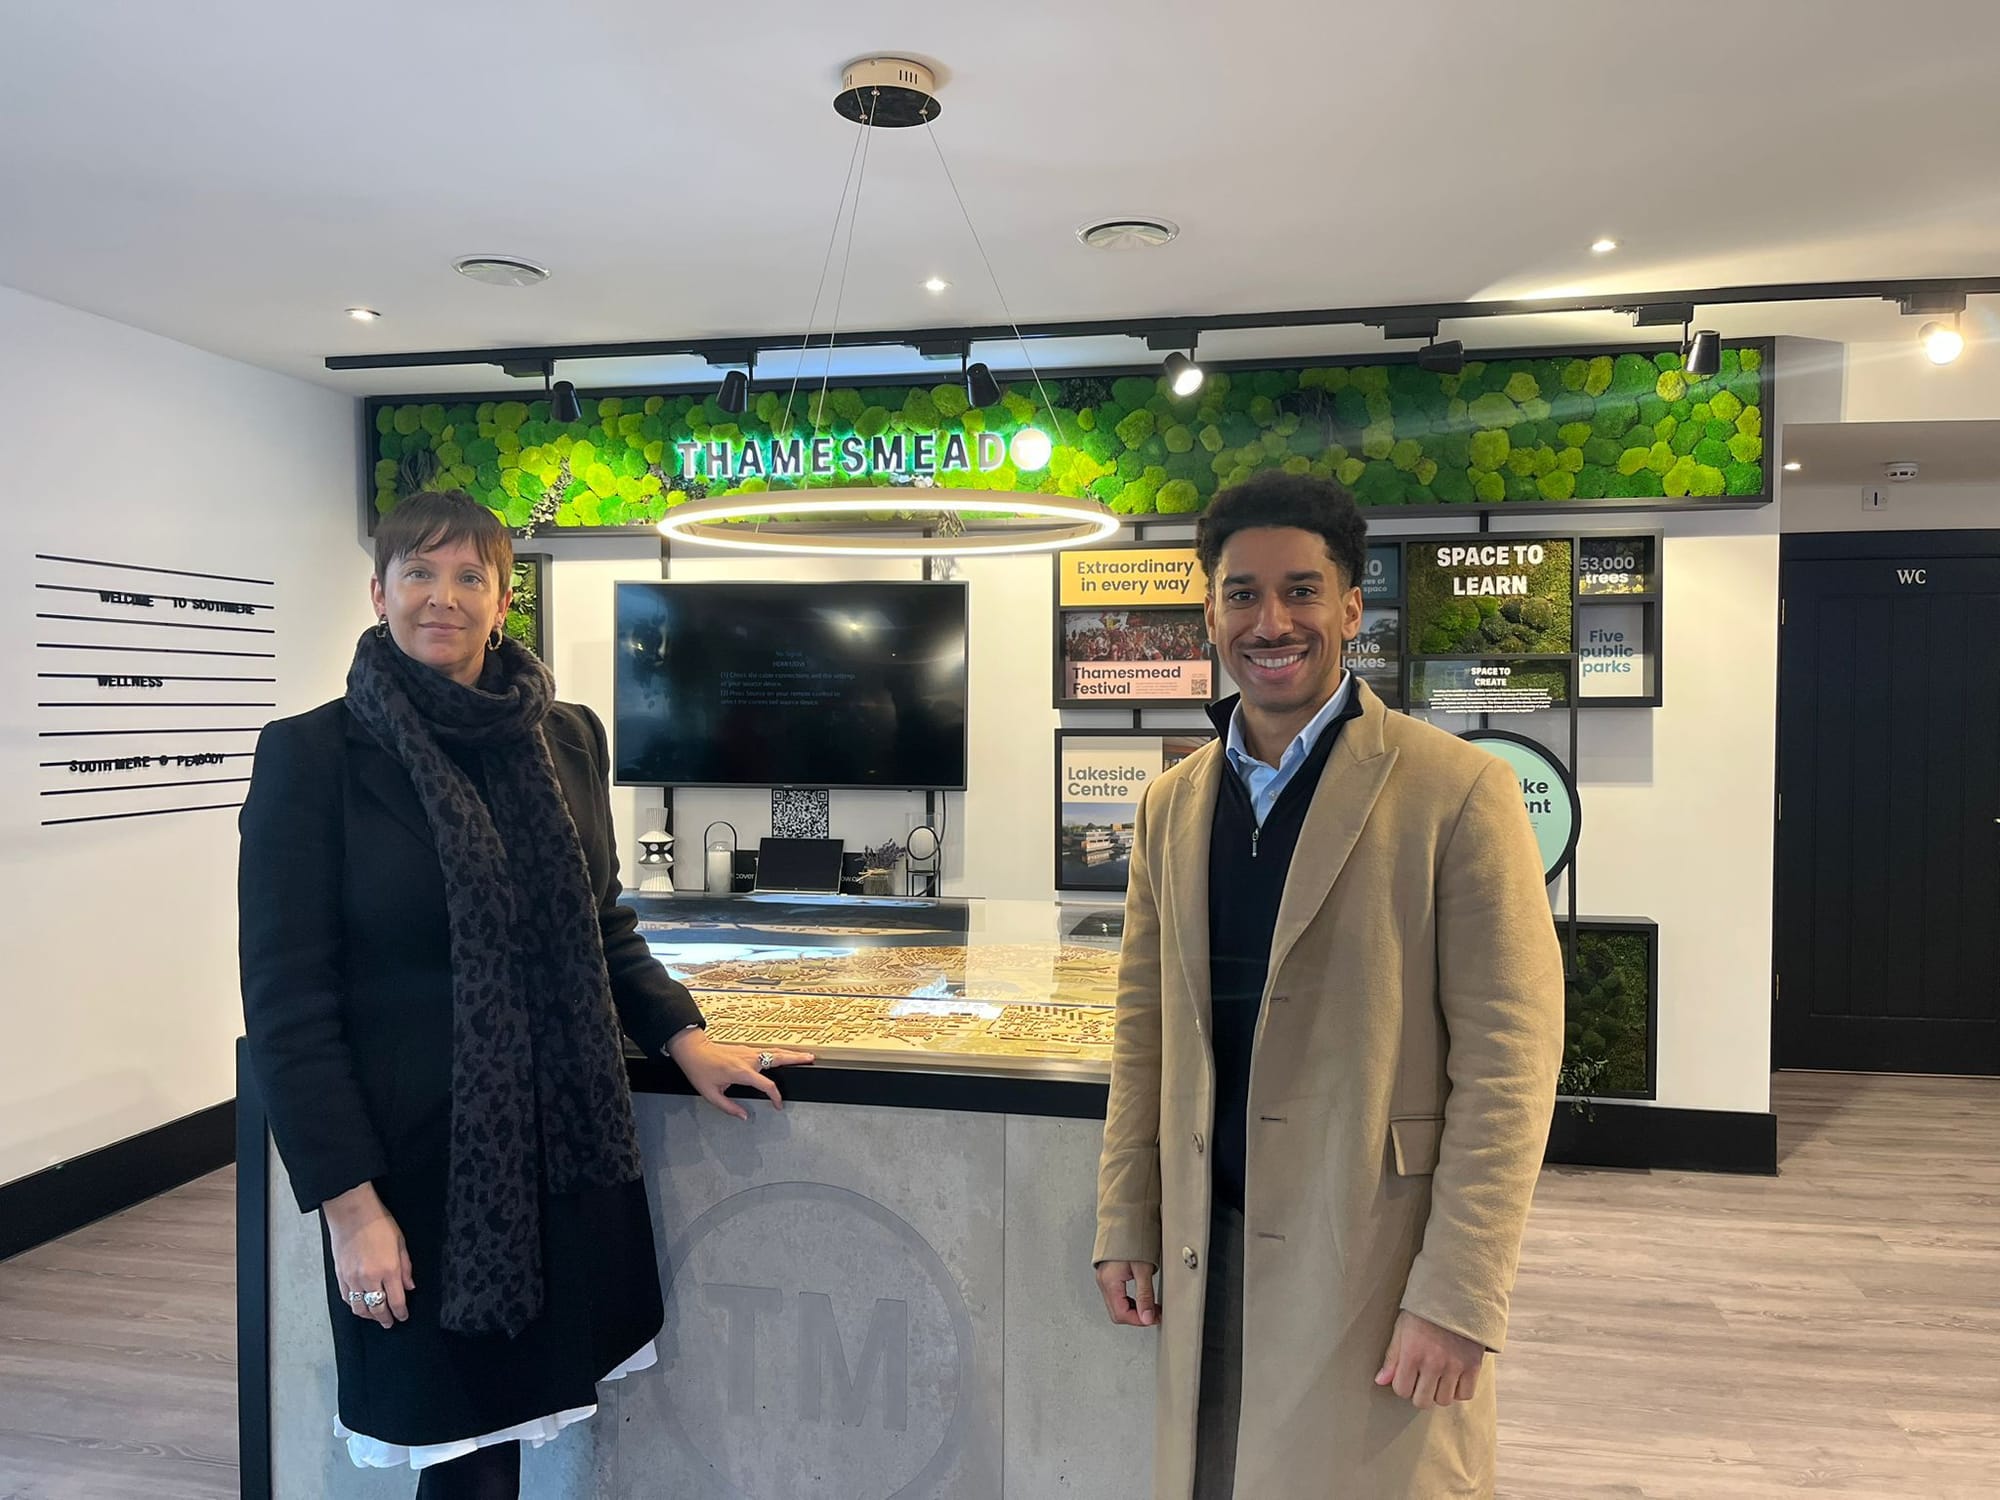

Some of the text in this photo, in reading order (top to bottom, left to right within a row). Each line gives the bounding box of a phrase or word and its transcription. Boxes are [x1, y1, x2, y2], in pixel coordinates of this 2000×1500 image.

[678, 432, 1004, 478] THAMESMEAD
[1437, 545, 1543, 567] SPACE TO
[1077, 559, 1194, 577] Extraordinary
[1580, 557, 1634, 572] 53,000
[1585, 572, 1629, 584] trees
[1897, 569, 1926, 584] WC
[1081, 578, 1190, 595] in every way
[1453, 575, 1527, 596] LEARN
[172, 597, 187, 608] TO
[1589, 629, 1624, 642] Five
[1347, 641, 1380, 654] Five
[1580, 644, 1633, 662] public
[1342, 655, 1386, 669] lakes
[1583, 661, 1631, 677] parks
[1072, 666, 1181, 679] Thamesmead
[1471, 667, 1511, 675] SPACE TO
[97, 676, 163, 687] WELLNESS
[1073, 682, 1130, 694] Festival
[1474, 678, 1507, 686] CREATE
[1068, 766, 1146, 781] Lakeside
[1068, 783, 1128, 796] Centre
[1519, 778, 1549, 794] ke
[702, 1283, 907, 1431] TM
